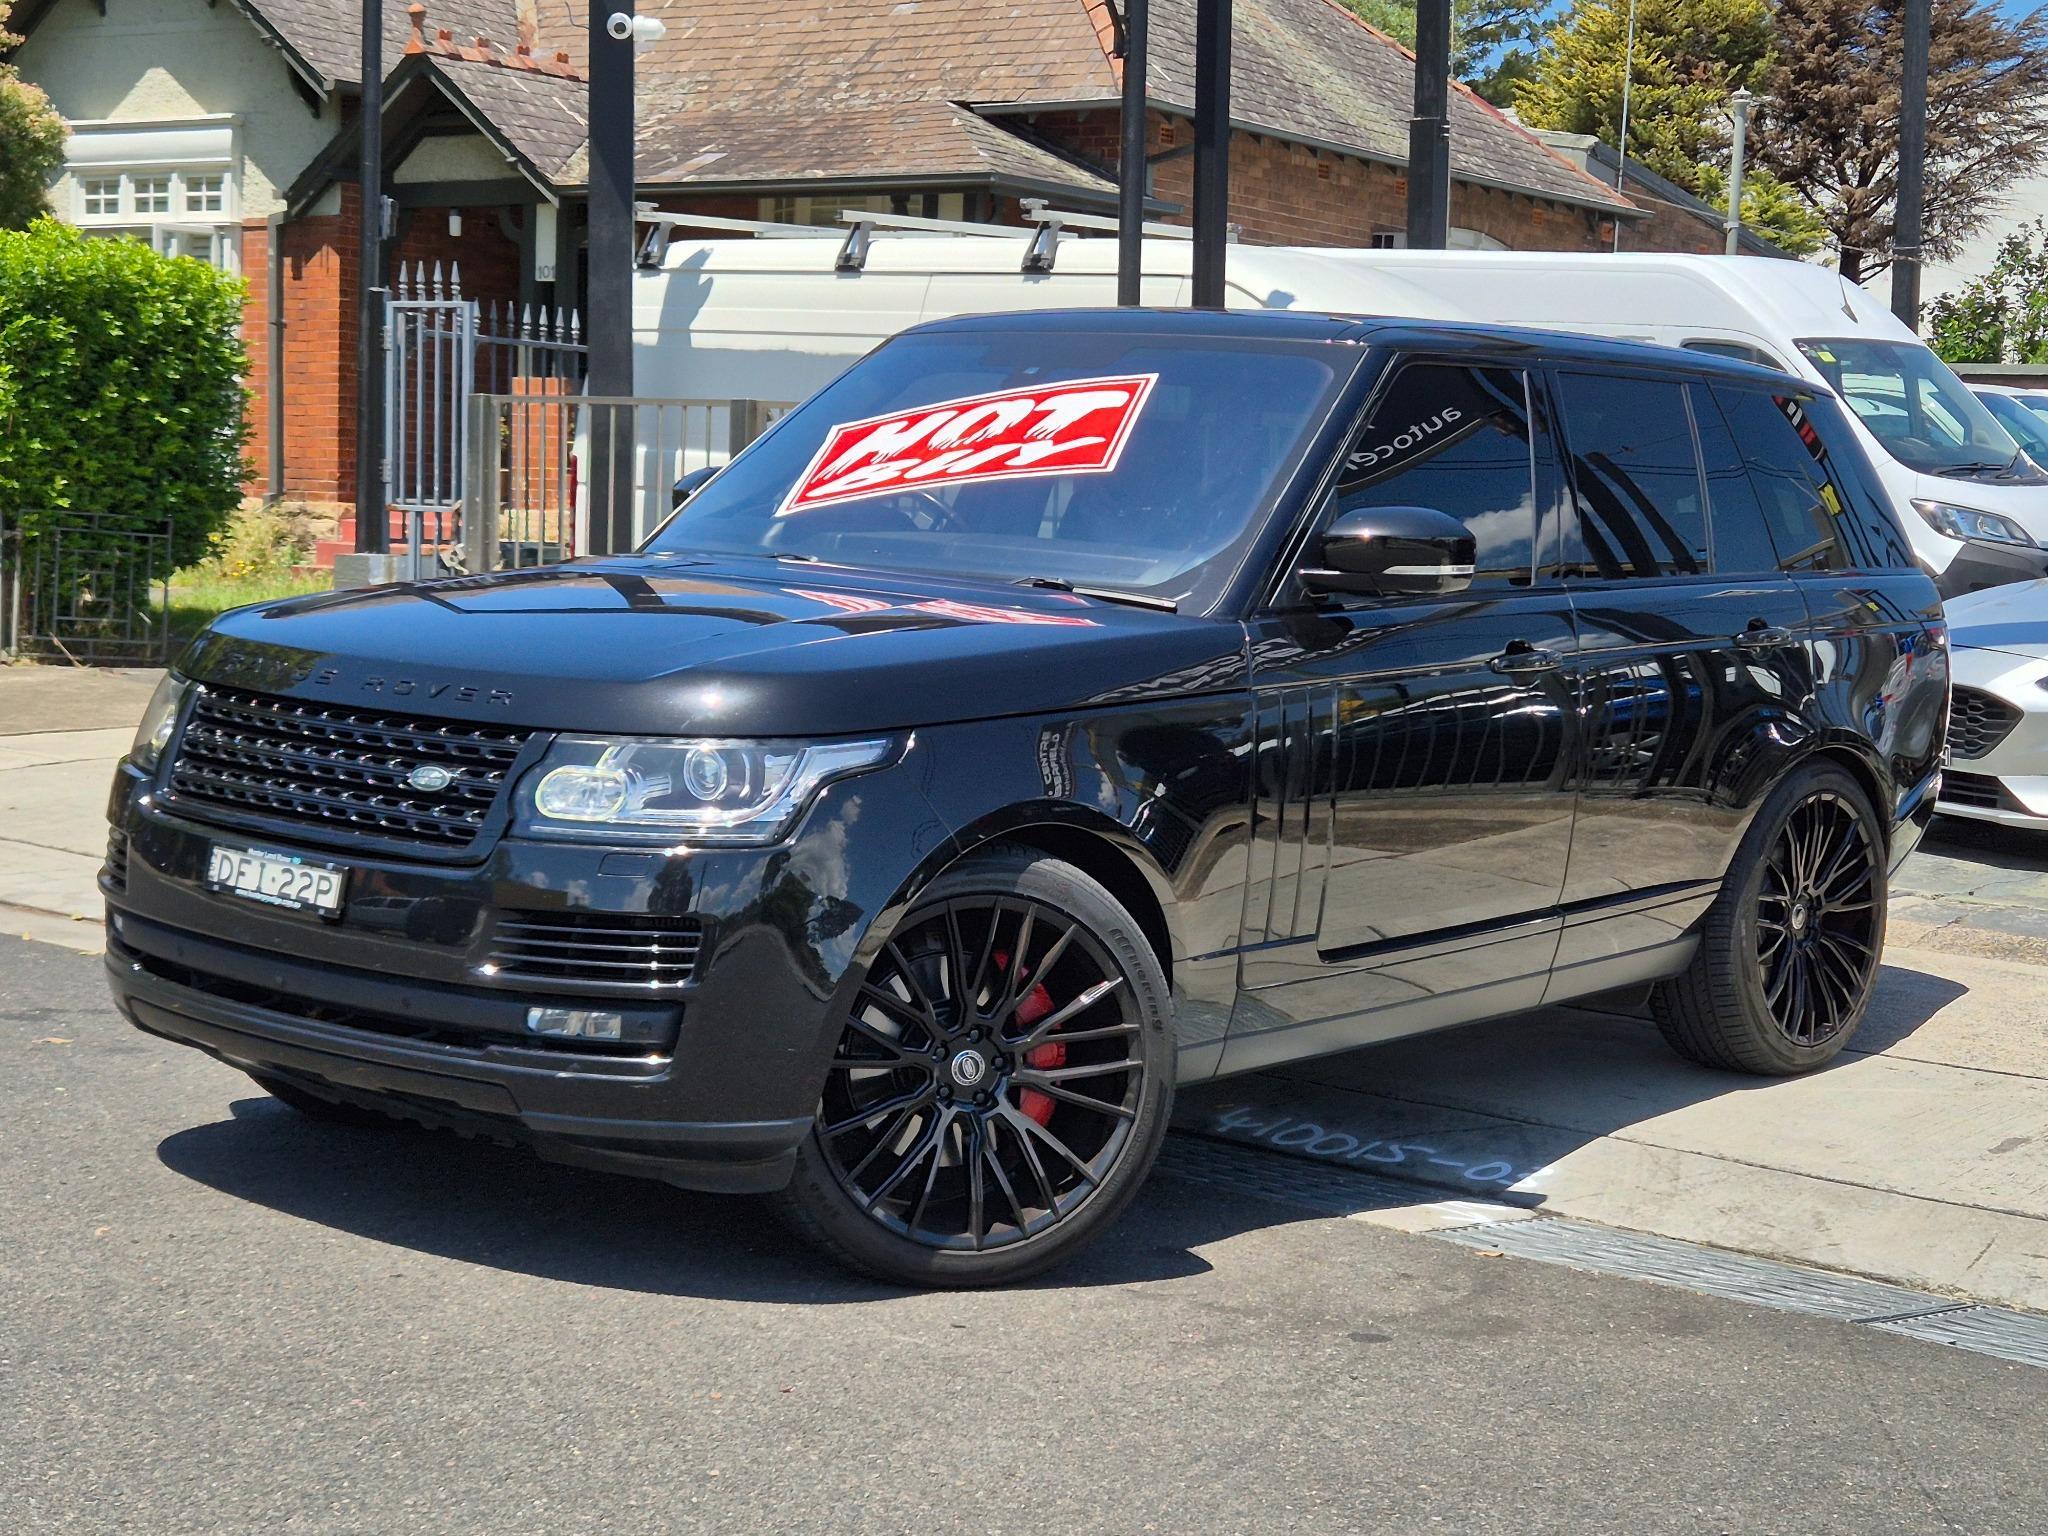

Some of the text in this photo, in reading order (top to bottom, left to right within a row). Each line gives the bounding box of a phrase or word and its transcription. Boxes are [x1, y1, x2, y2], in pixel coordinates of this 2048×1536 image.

[538, 265, 556, 279] 101
[811, 390, 1130, 484] HOT
[805, 436, 1106, 497] BUY
[361, 674, 513, 705] ROVER
